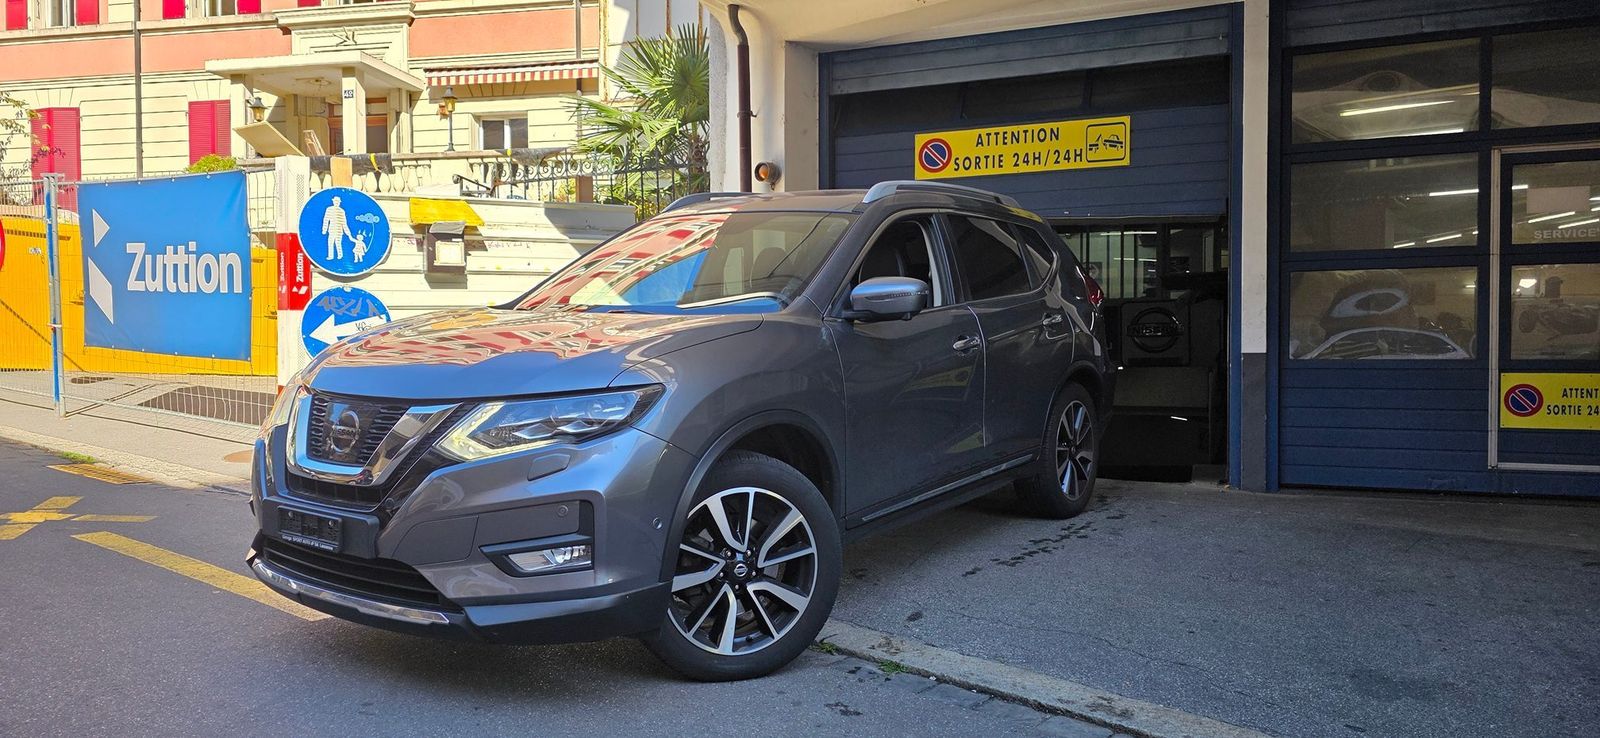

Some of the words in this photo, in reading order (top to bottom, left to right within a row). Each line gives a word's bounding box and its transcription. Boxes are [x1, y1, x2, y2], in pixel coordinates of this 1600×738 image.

[975, 127, 1060, 148] ATTENTION
[953, 154, 1004, 172] SORTIE
[1012, 148, 1083, 168] 24H/24H
[1534, 227, 1600, 239] SERVICE
[126, 241, 243, 294] Zuttion
[296, 252, 304, 283] Zuttion
[1561, 388, 1600, 399] ATTENT
[1546, 404, 1582, 416] SORTIE
